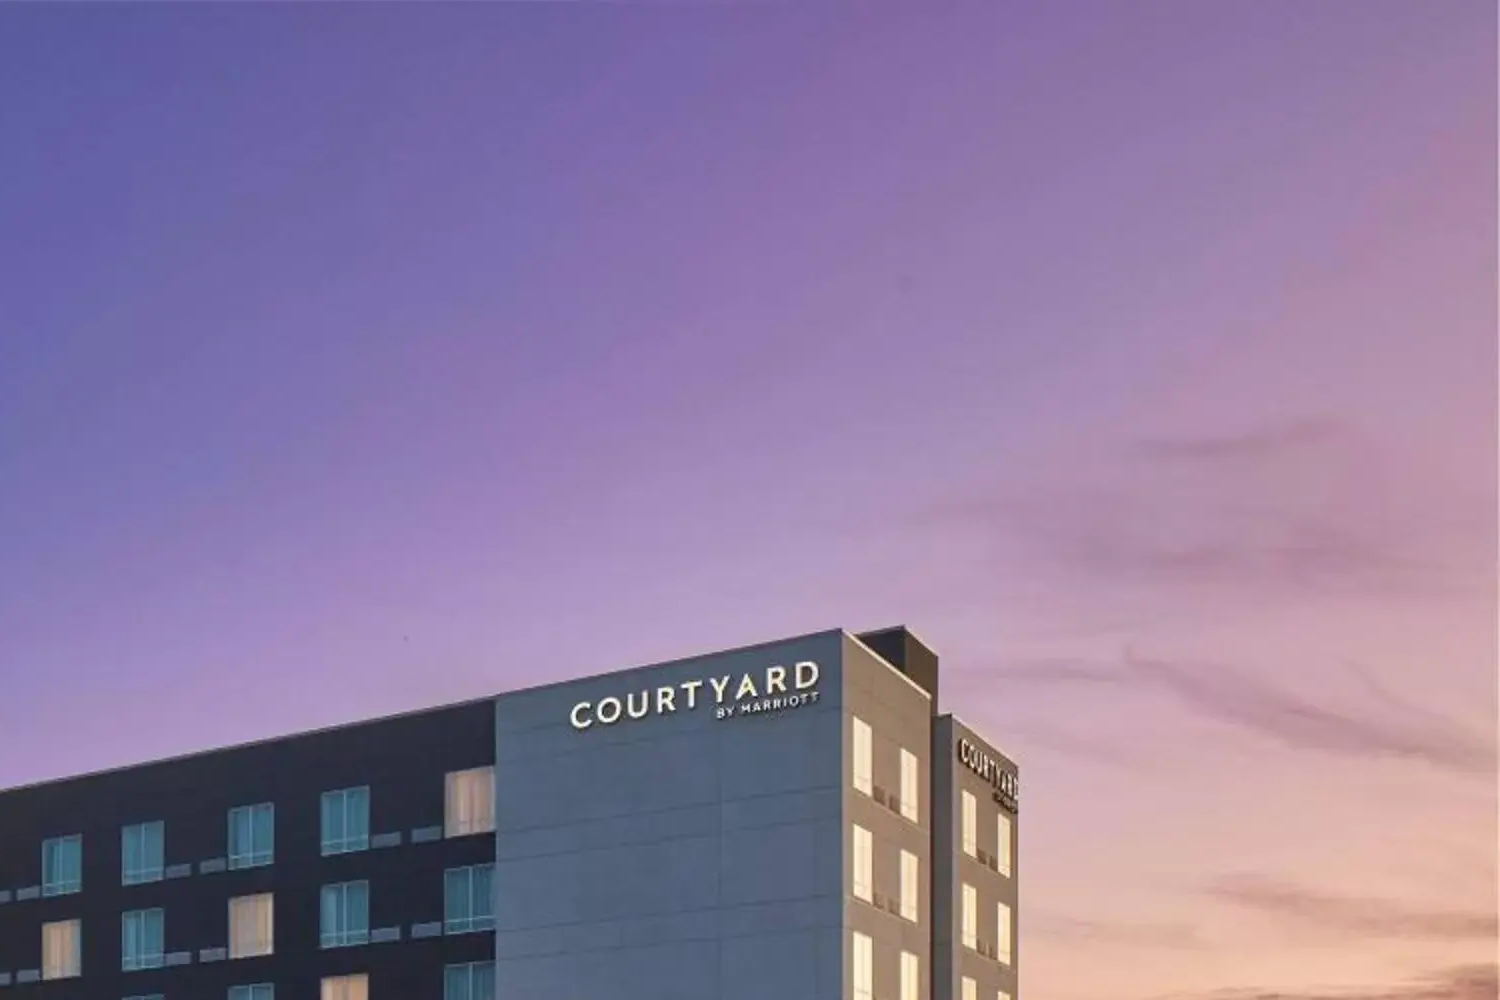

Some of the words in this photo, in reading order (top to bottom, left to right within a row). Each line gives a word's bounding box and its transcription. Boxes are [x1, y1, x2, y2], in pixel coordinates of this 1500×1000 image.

[569, 661, 820, 729] COURTYARD
[716, 705, 735, 719] BY
[741, 691, 820, 713] MARRIOTT
